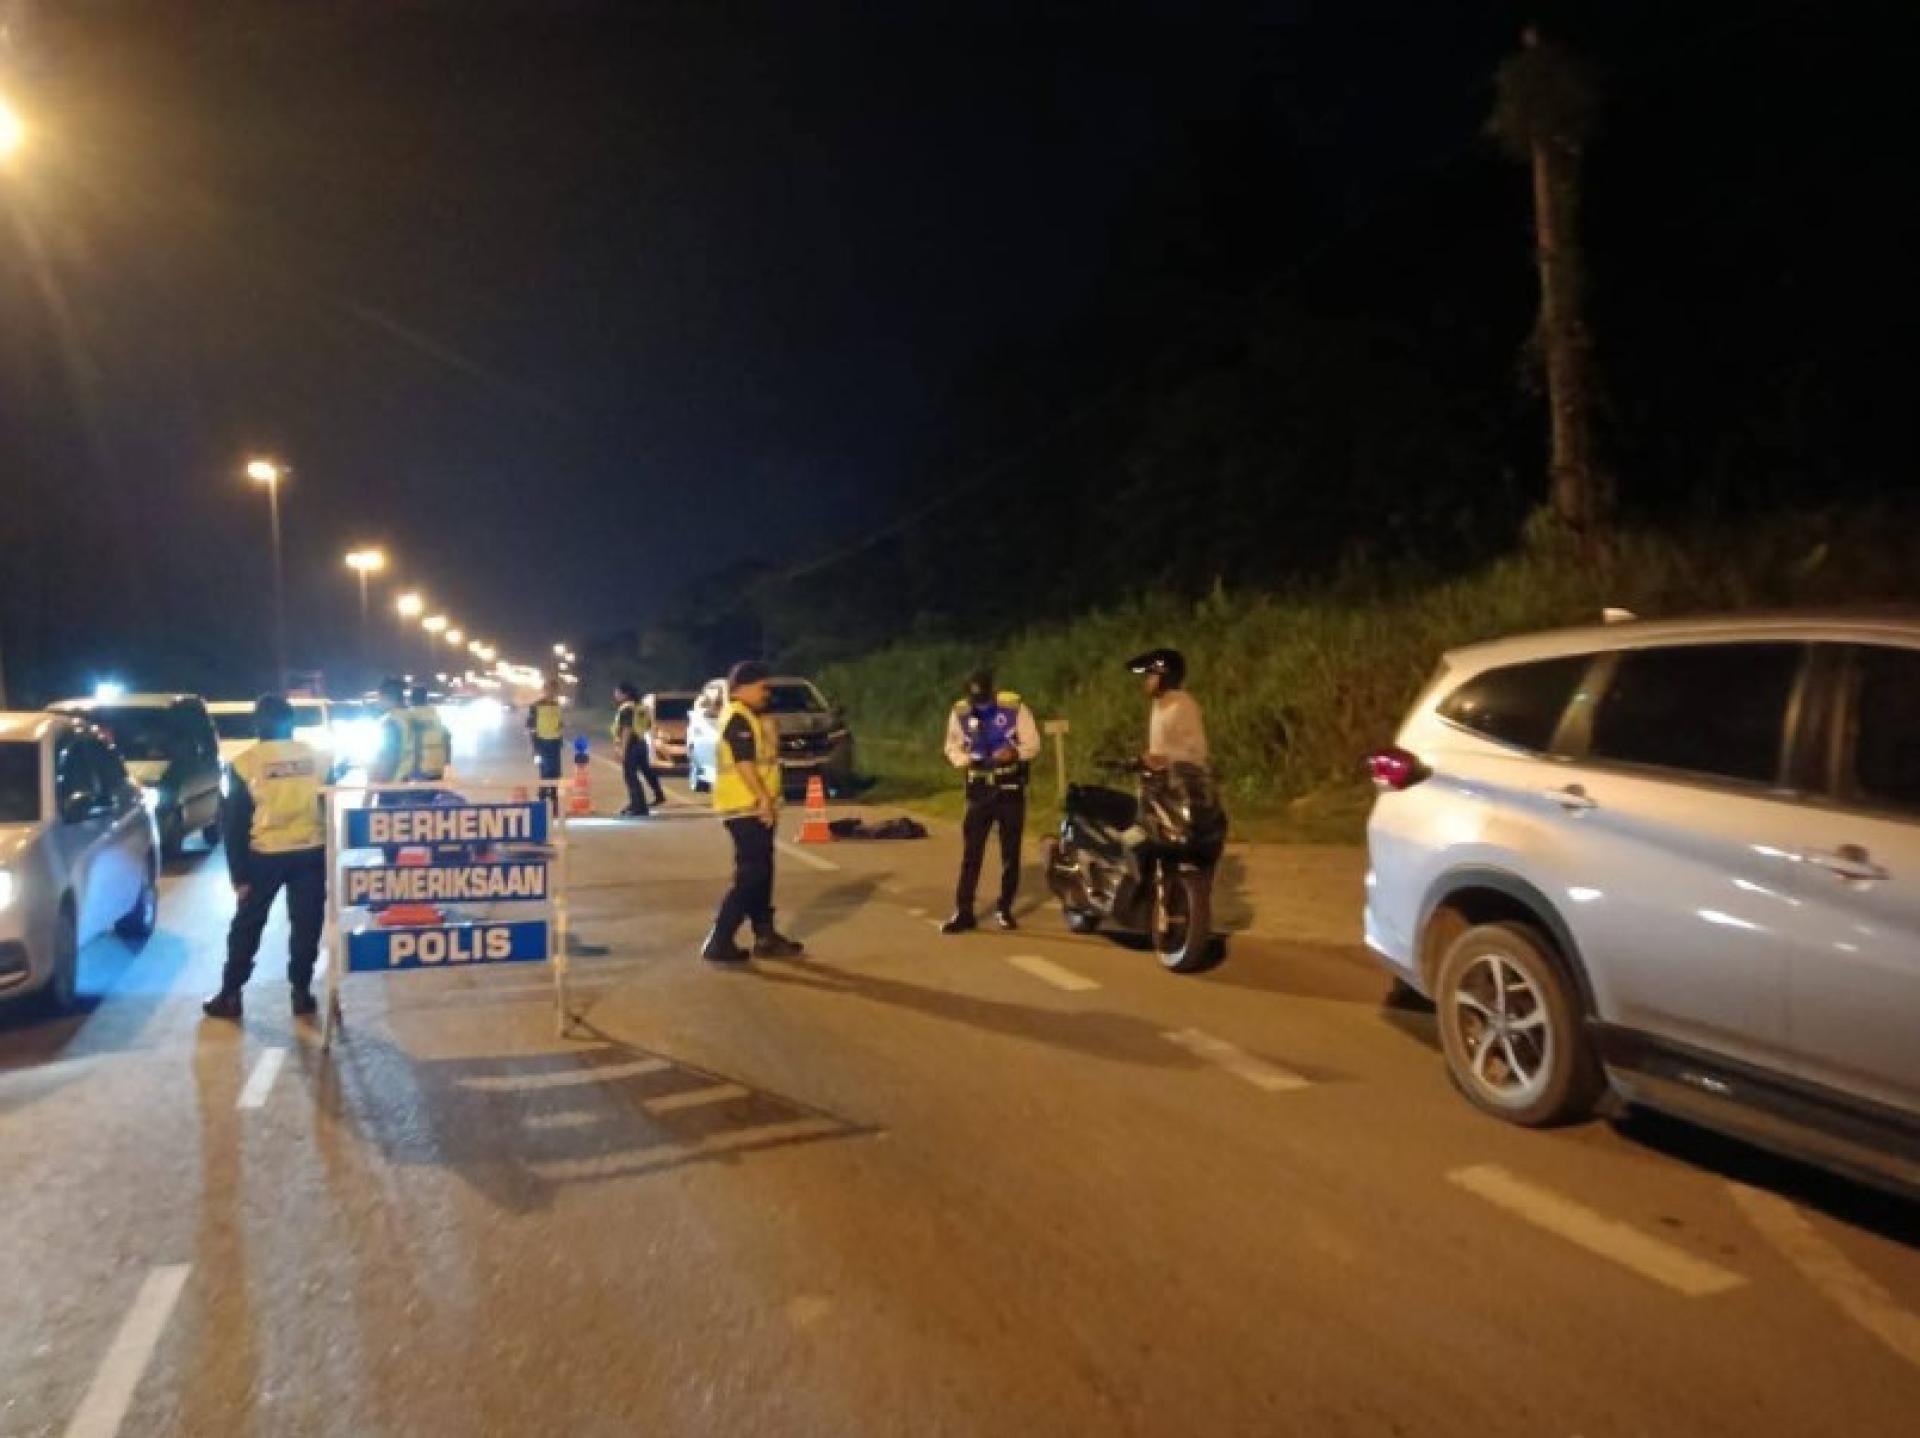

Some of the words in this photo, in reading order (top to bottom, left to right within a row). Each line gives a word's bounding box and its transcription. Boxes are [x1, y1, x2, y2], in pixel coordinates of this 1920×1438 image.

[369, 807, 531, 843] BERHENTI
[350, 864, 543, 904] PEMERIKSAAN
[389, 927, 512, 966] POLIS
